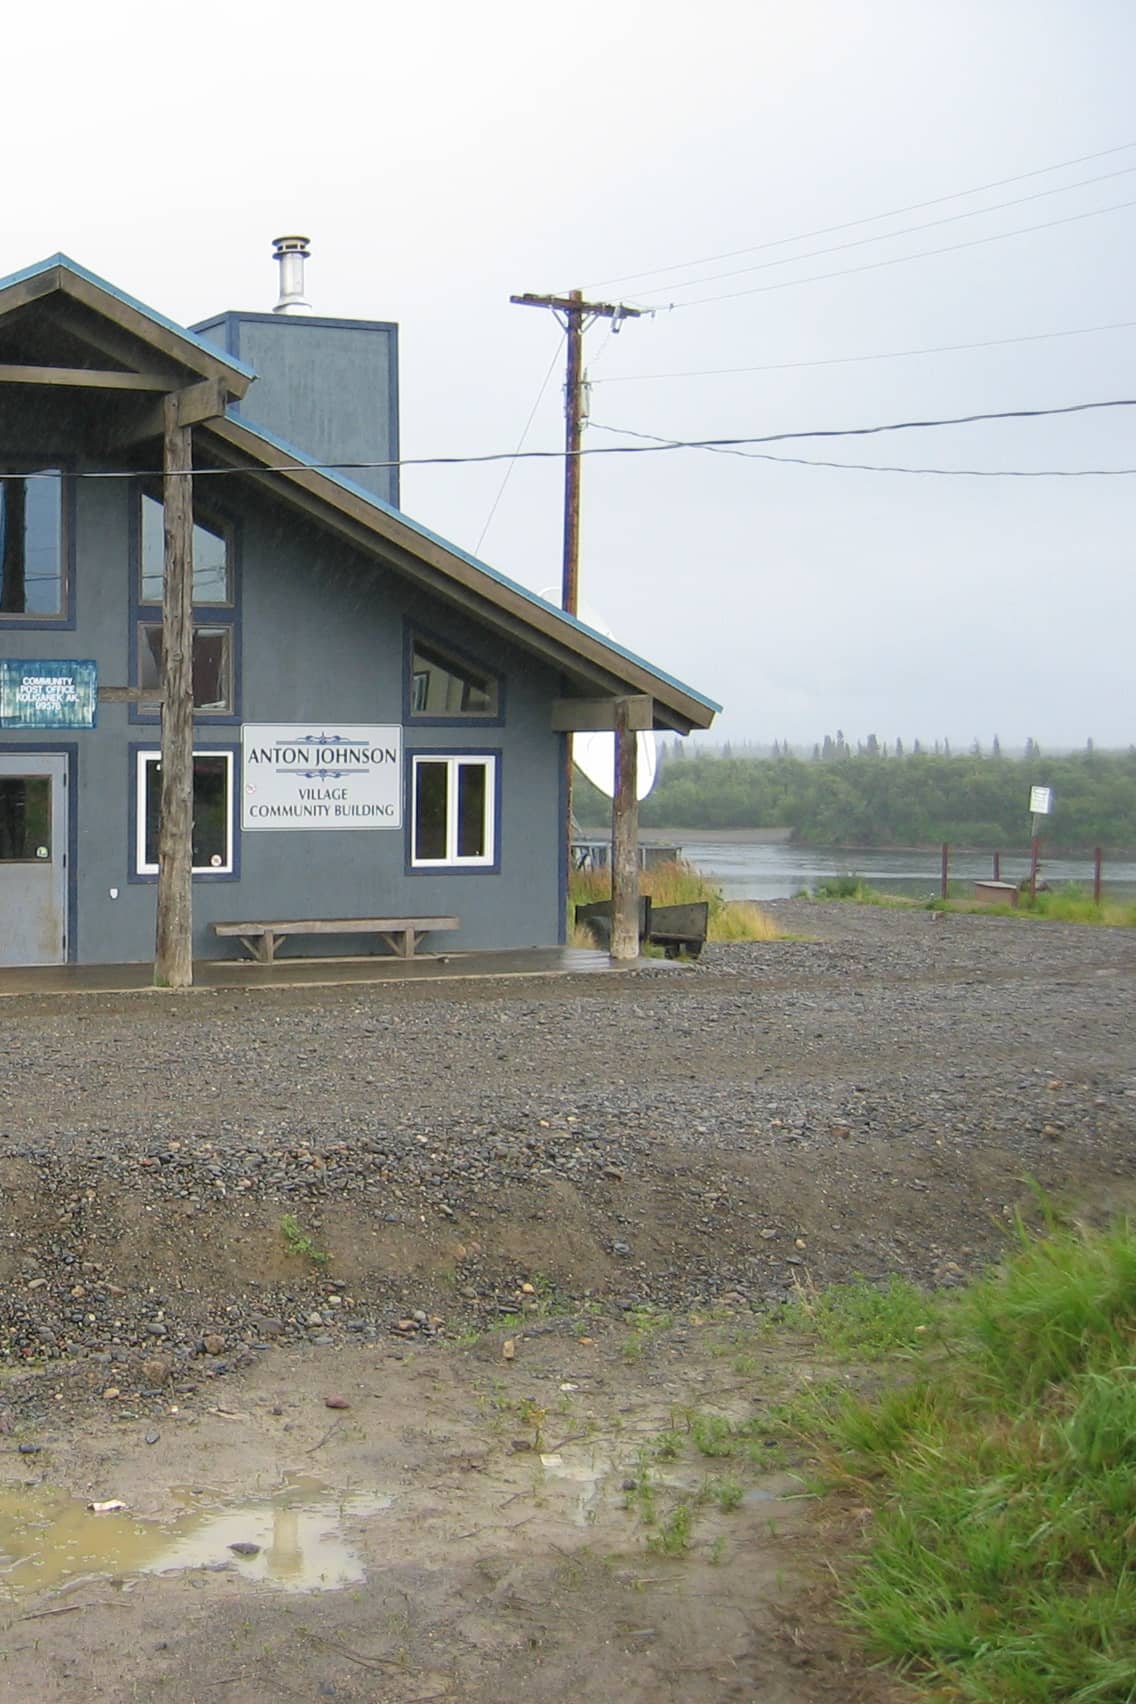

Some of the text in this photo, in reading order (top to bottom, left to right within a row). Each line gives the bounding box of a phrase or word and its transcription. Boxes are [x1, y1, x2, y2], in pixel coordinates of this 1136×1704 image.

[22, 676, 73, 685] COMMUNITY
[20, 685, 75, 694] POST OFFICE
[248, 747, 397, 766] ANTON JOHNSON
[298, 788, 348, 801] VILLAGE
[249, 804, 394, 817] COMMUNITY BUILDING
